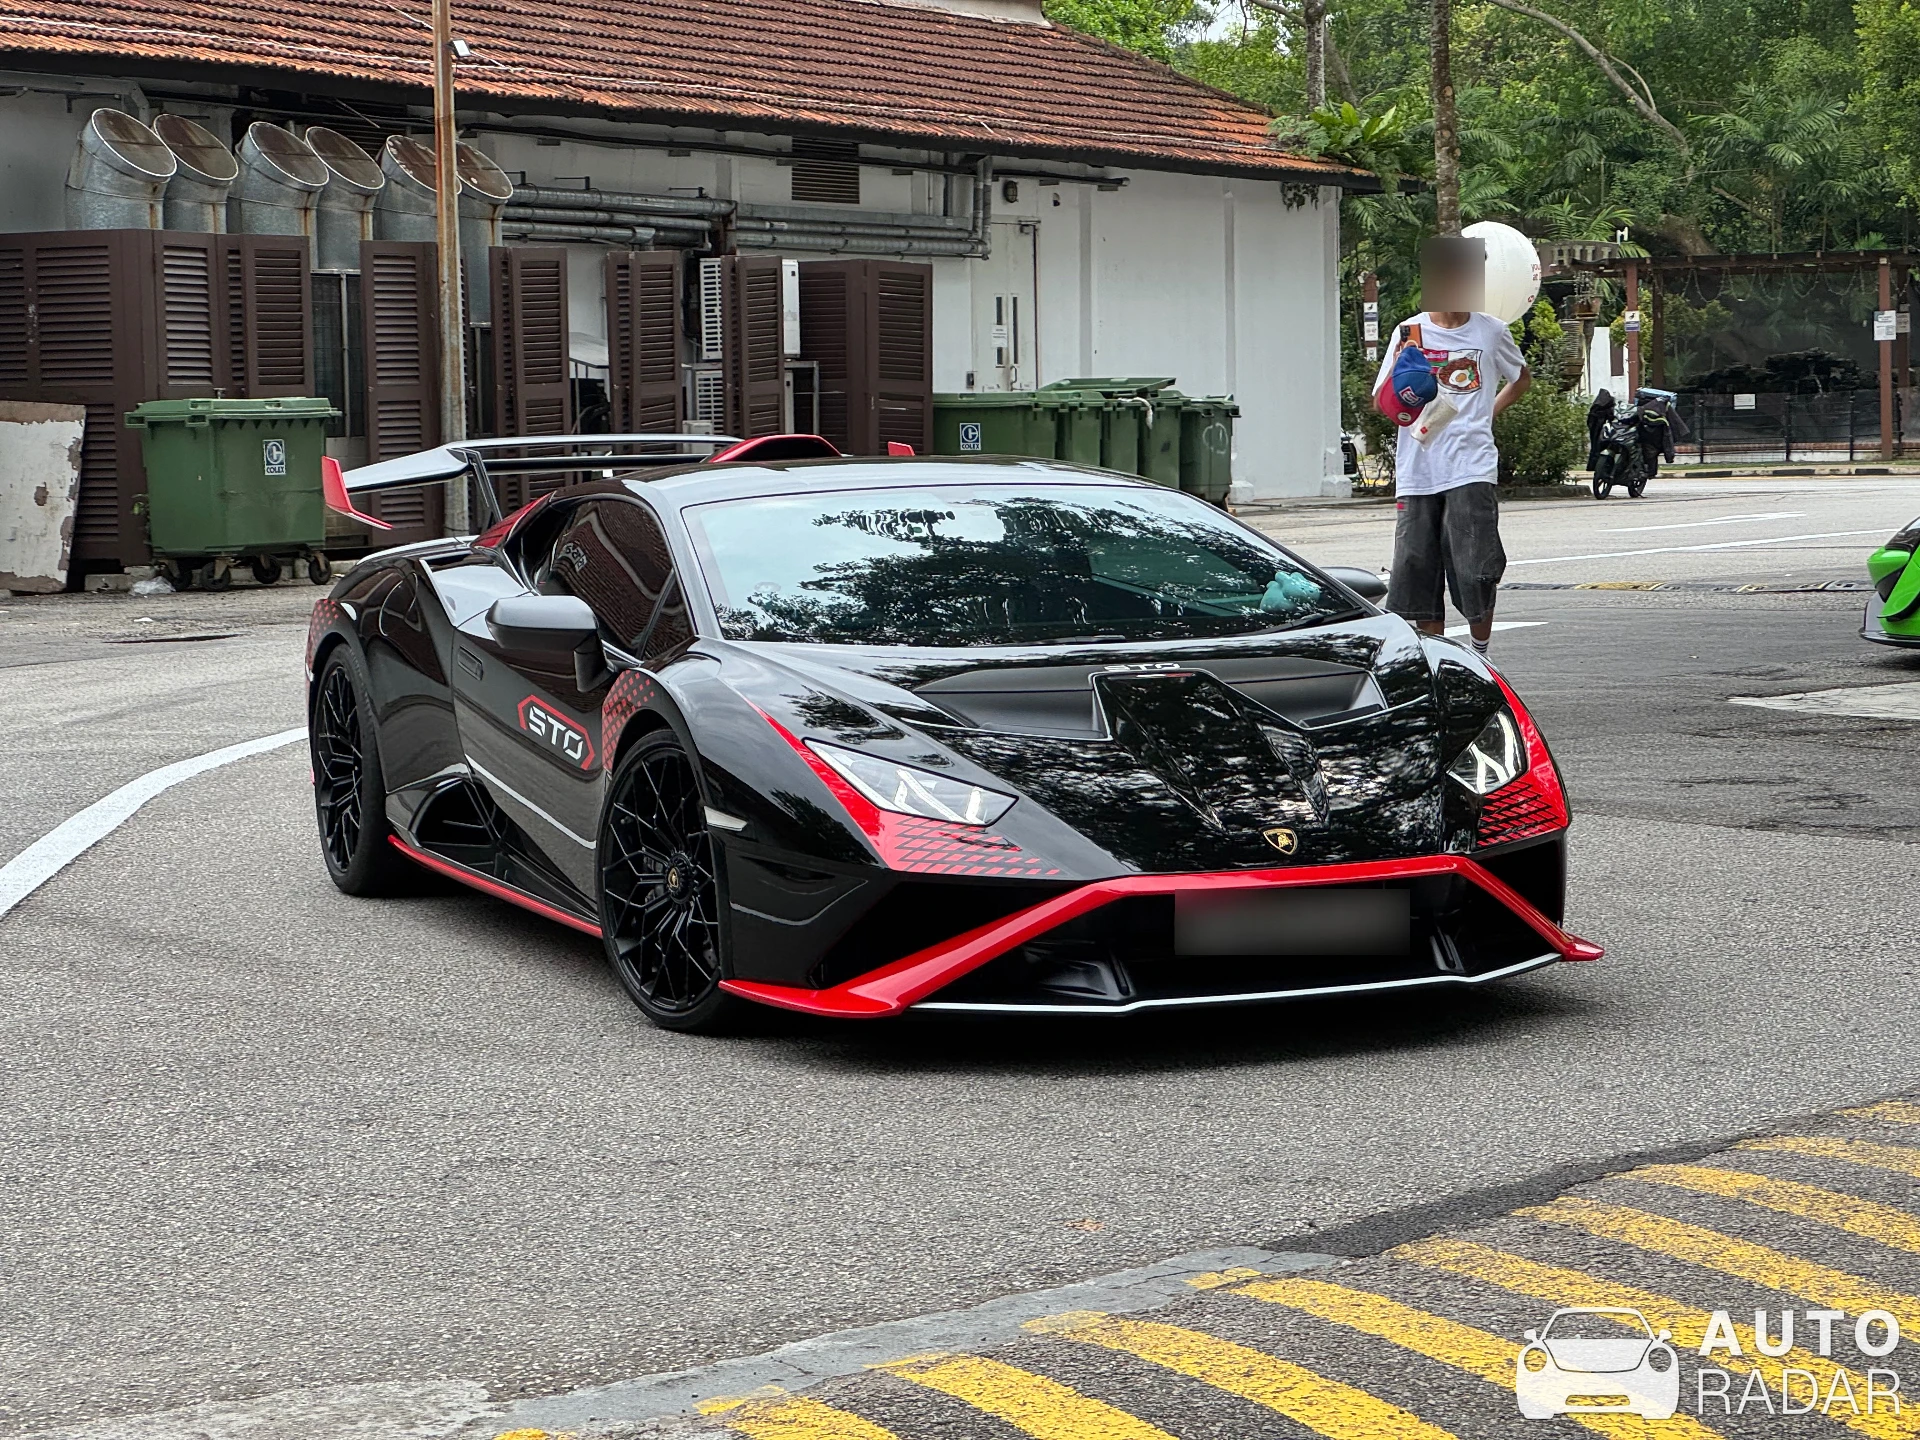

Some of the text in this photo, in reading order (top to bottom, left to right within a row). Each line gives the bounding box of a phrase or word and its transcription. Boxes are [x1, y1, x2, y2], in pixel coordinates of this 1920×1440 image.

[266, 466, 285, 474] COLEX
[1104, 662, 1180, 672] STO
[528, 705, 583, 760] STO
